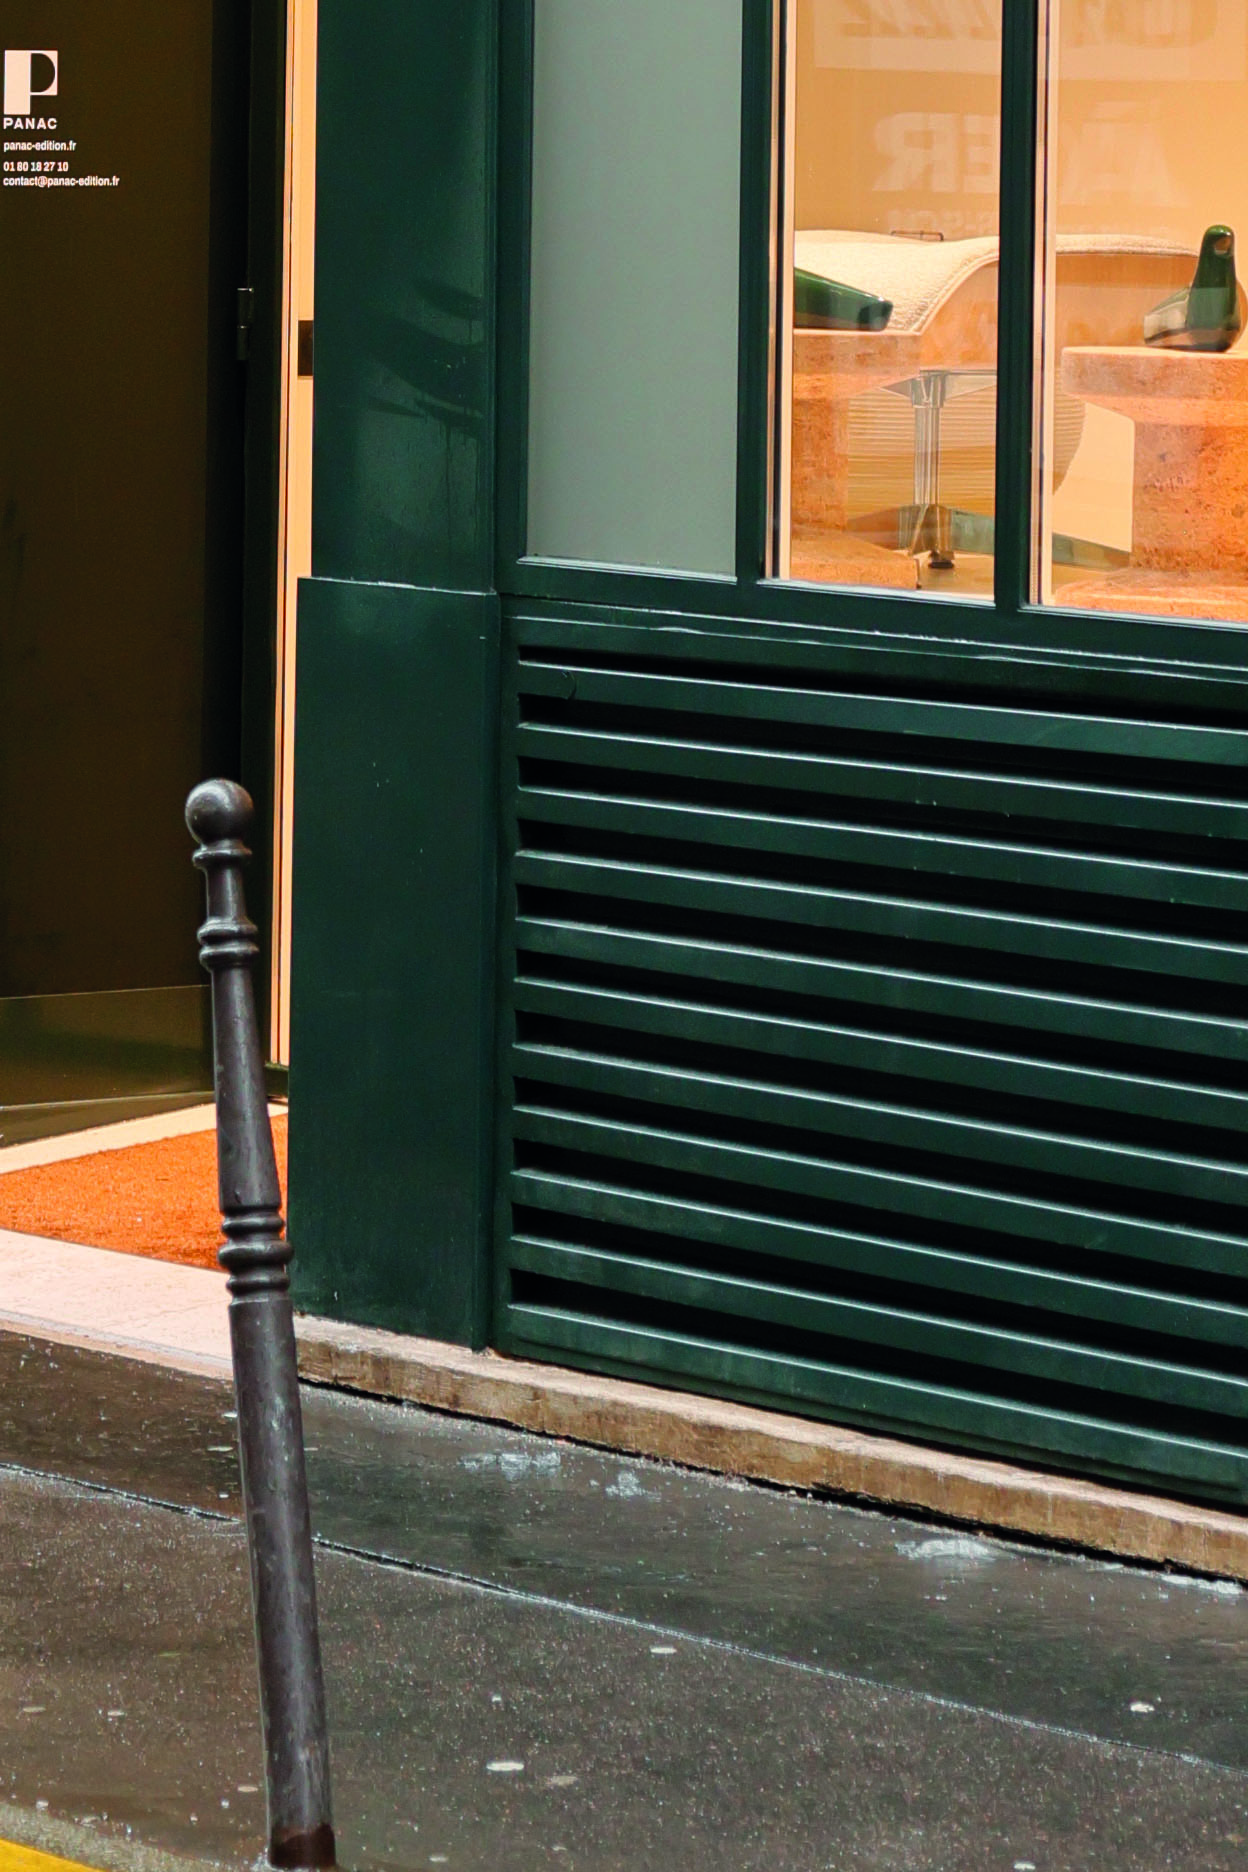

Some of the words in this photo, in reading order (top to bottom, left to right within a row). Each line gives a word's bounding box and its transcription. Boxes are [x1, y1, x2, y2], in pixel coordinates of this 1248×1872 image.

[3, 117, 58, 130] PANAC
[3, 139, 77, 153] panac-edition.fr
[3, 161, 15, 172] 01
[17, 161, 29, 172] 80
[31, 161, 42, 172] 18
[43, 161, 56, 172] 27
[57, 161, 69, 172] 10
[3, 175, 121, 188] contact@panac-edition.fr
